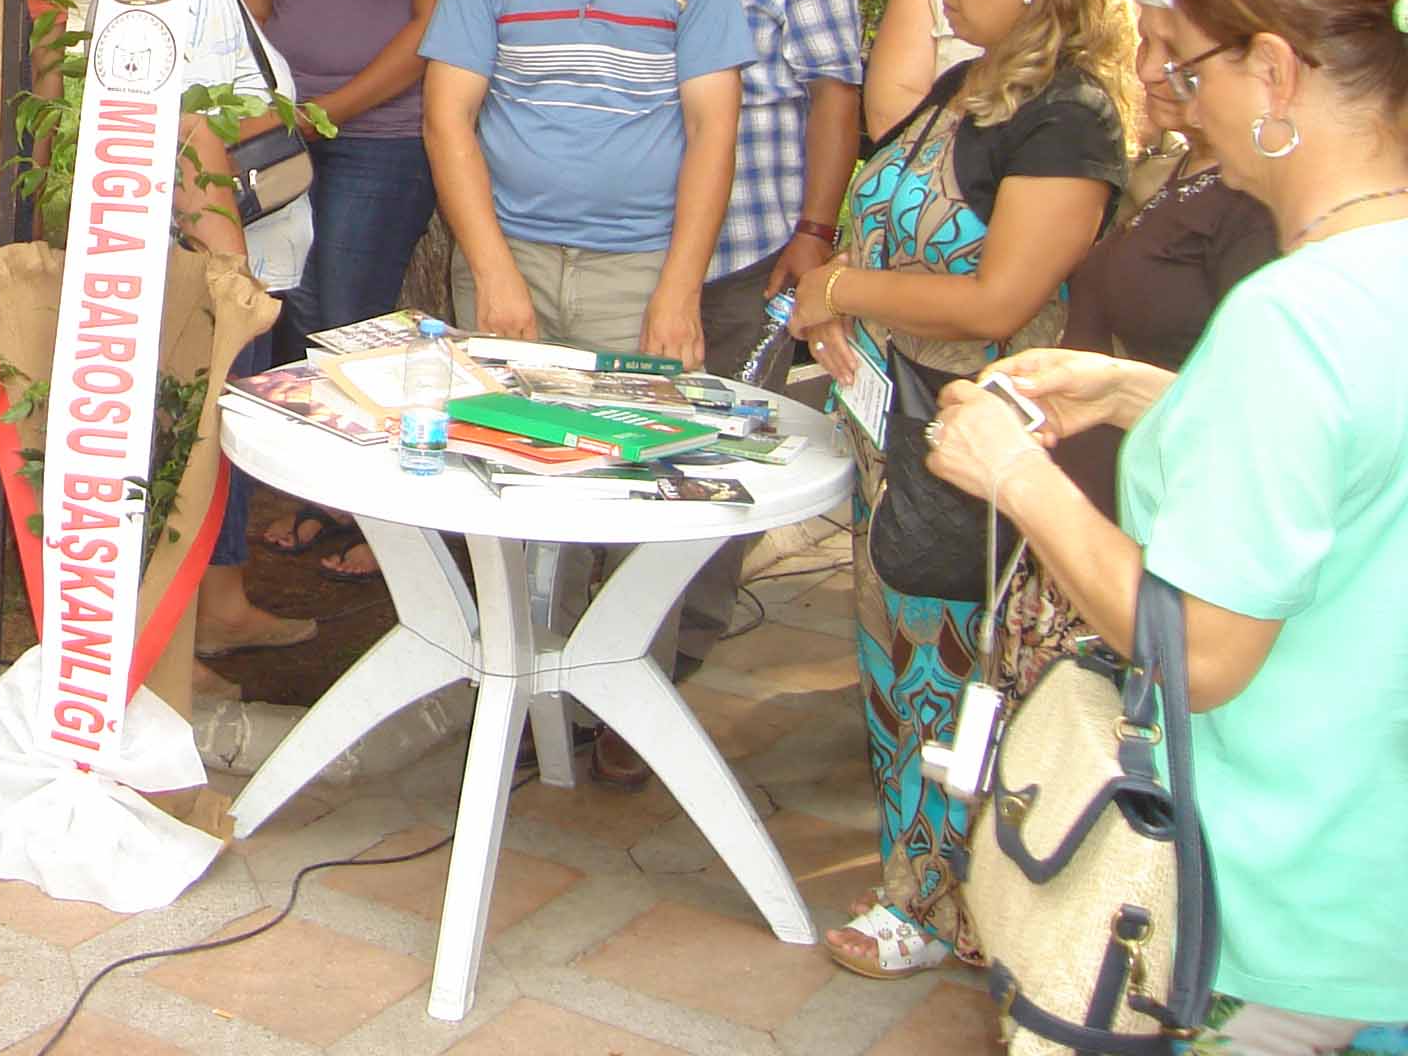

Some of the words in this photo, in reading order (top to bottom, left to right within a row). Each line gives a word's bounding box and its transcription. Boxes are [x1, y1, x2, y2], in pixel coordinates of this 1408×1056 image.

[87, 99, 167, 255] MUĞLA
[66, 272, 142, 459] BAROSU
[46, 473, 124, 751] BAŞKANLIĞI
